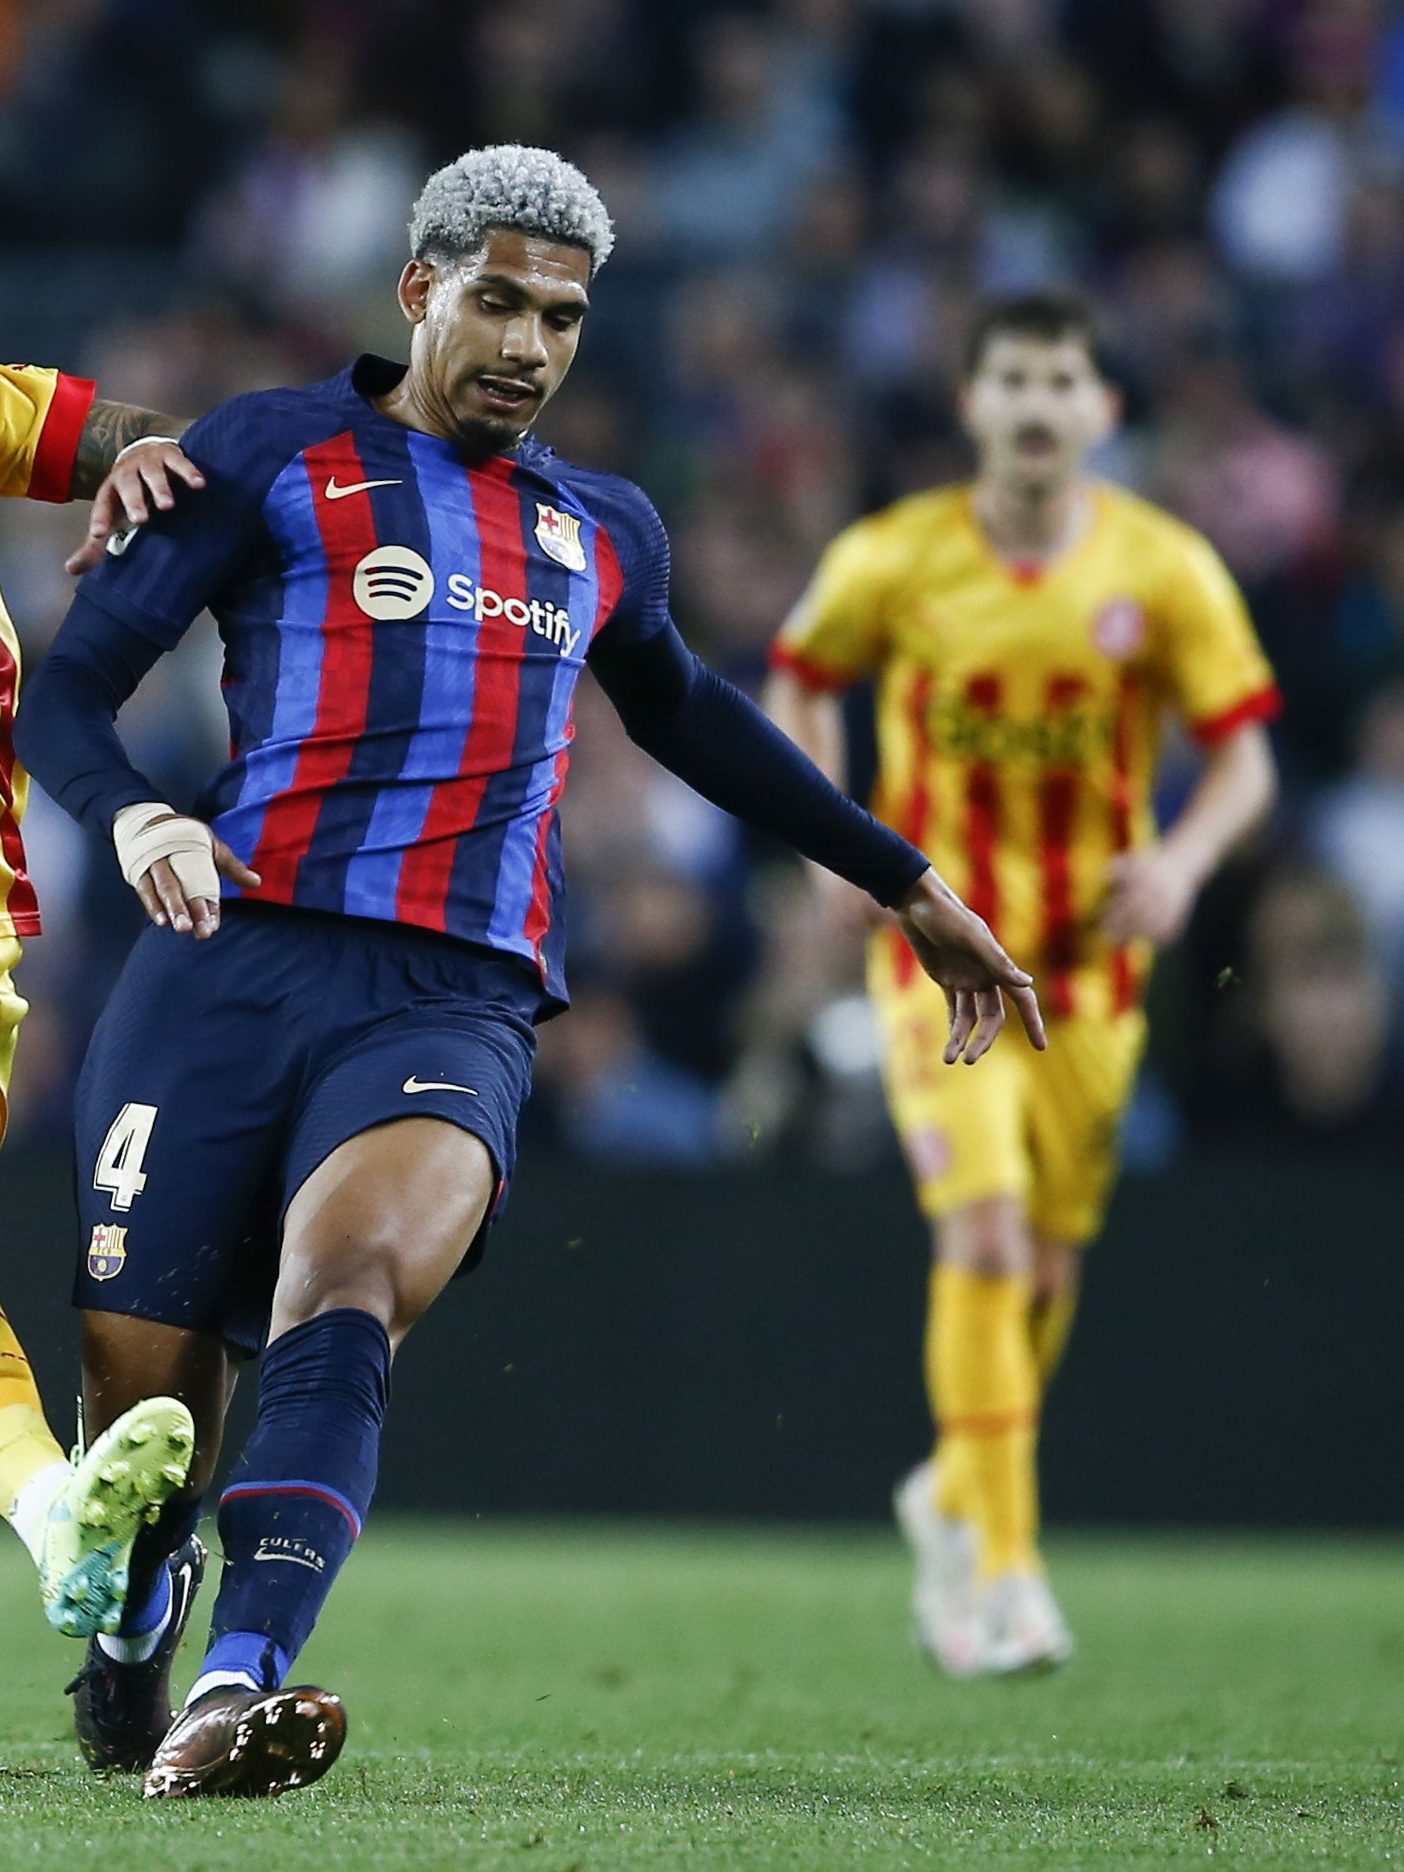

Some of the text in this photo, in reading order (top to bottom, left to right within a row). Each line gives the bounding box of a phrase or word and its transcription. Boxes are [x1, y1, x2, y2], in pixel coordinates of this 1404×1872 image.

[446, 573, 582, 658] Spotify
[93, 1102, 159, 1213] 4
[258, 1537, 326, 1569] CULERS
